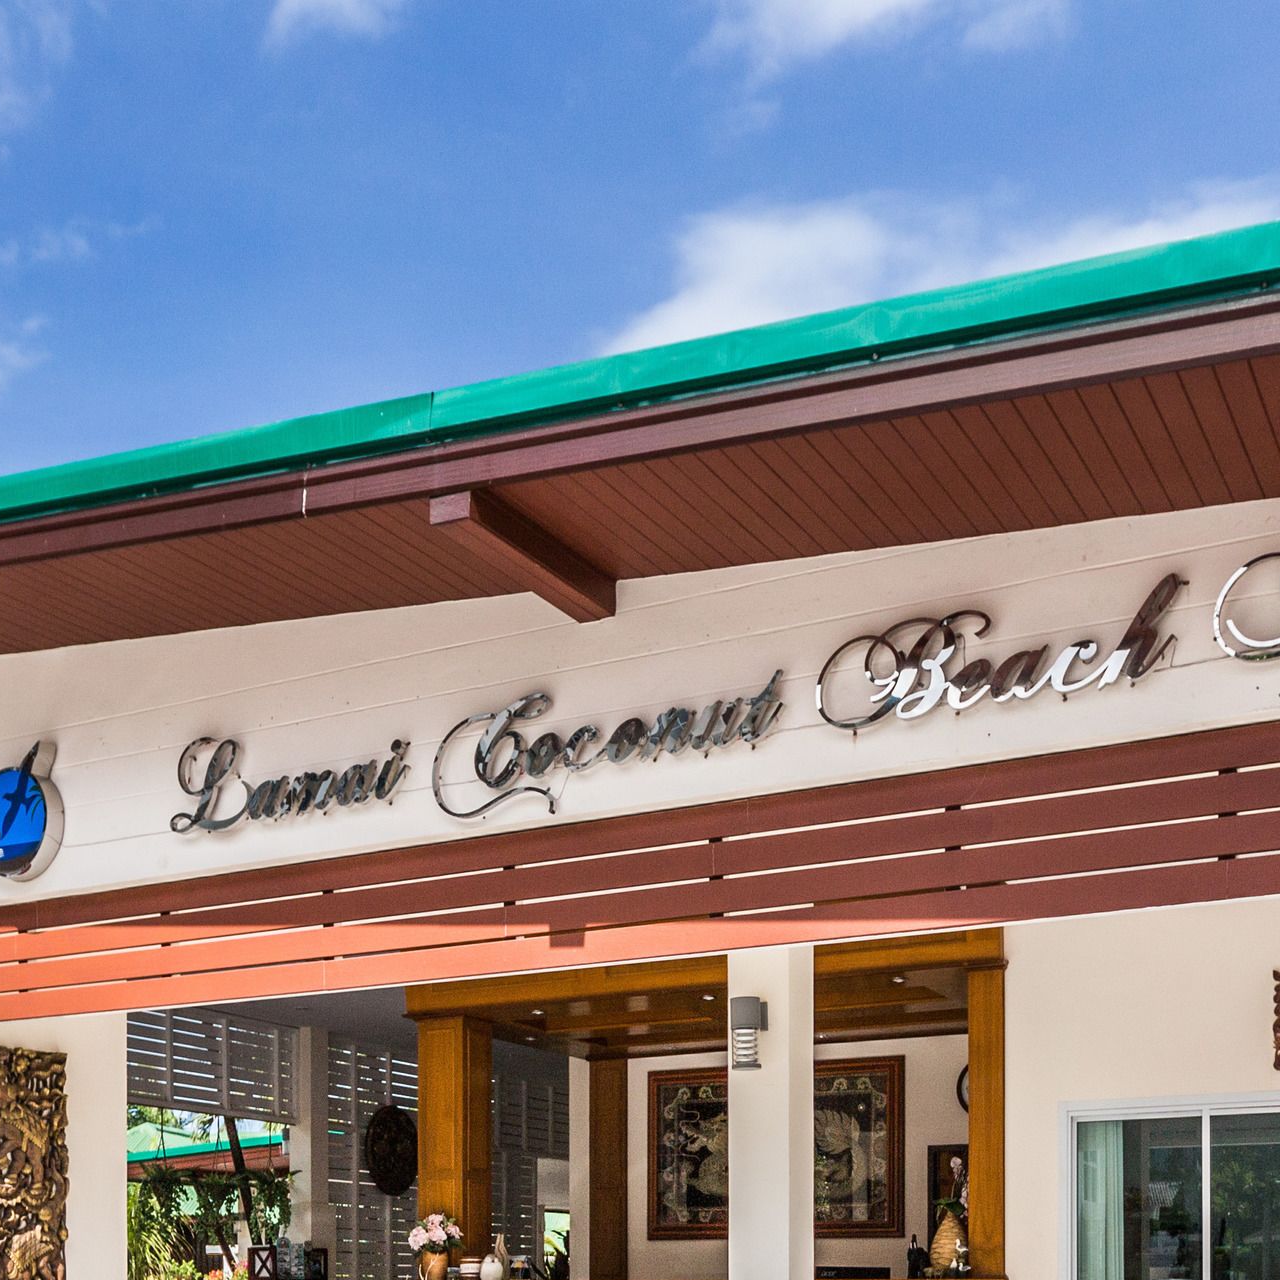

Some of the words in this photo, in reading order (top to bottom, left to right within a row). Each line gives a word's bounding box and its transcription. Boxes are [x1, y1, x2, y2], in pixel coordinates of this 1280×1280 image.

[170, 736, 411, 834] Lamai
[432, 668, 785, 820] Coconut
[815, 572, 1191, 732] Beach
